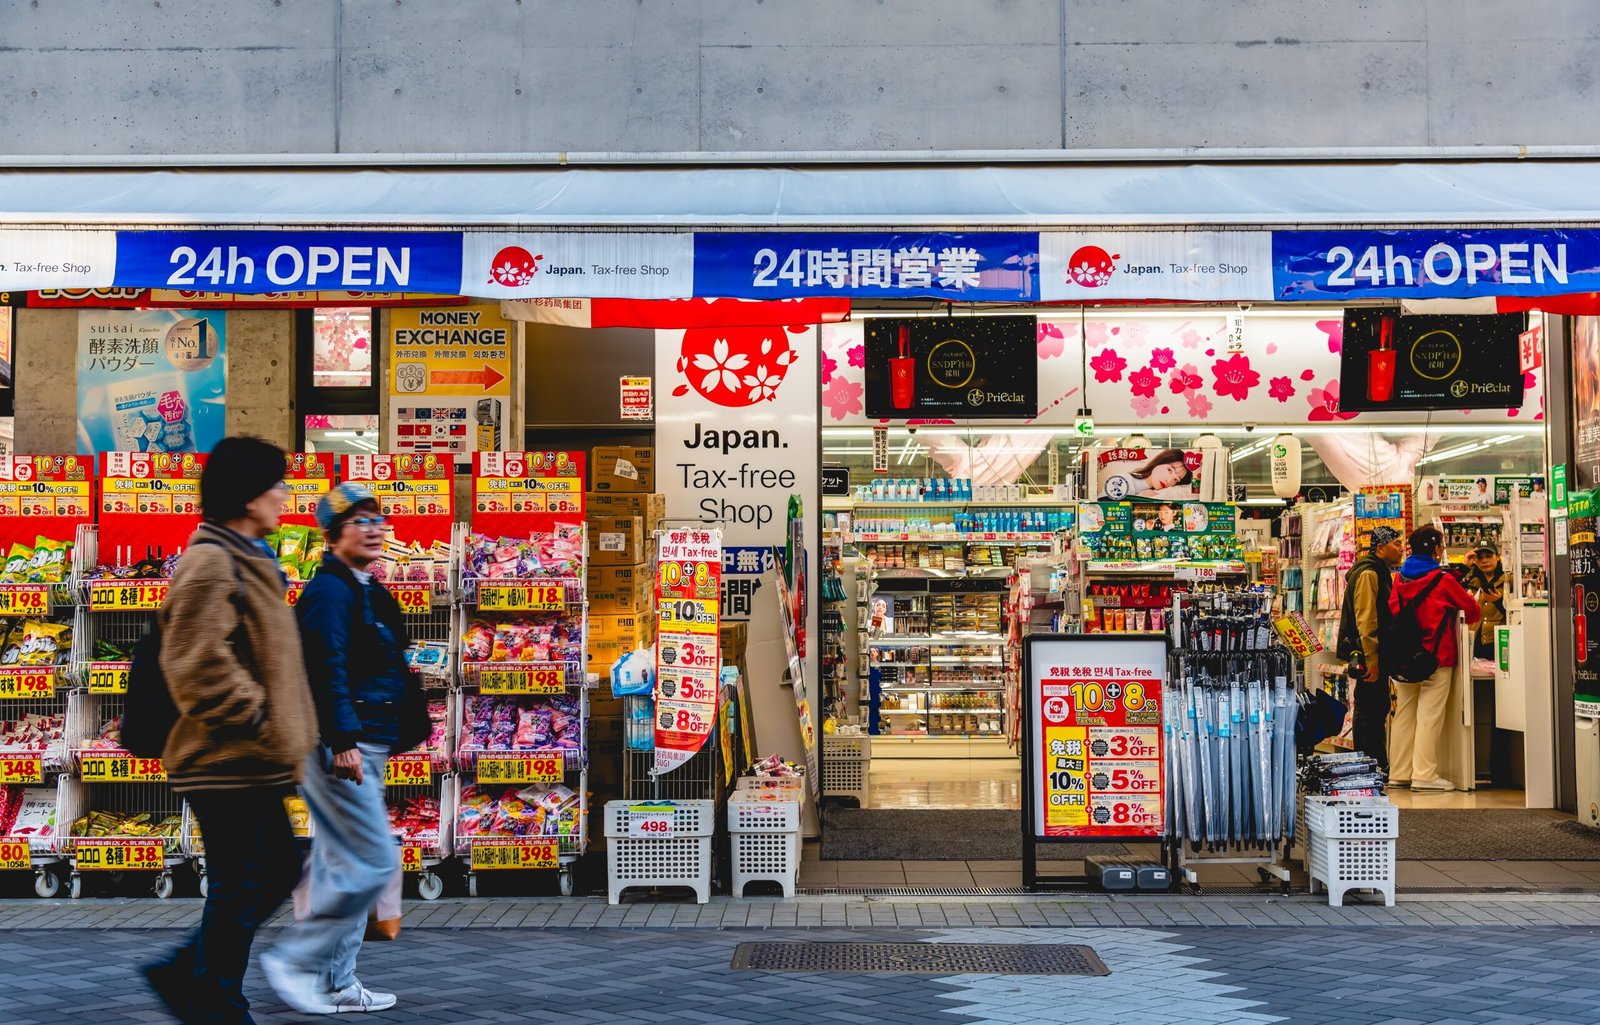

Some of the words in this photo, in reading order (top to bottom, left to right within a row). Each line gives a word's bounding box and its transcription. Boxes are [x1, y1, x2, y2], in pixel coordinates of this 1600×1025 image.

[13, 262, 59, 274] Tax-free
[62, 262, 91, 276] Shop
[167, 245, 255, 286] 24h
[265, 245, 409, 287] OPEN
[545, 264, 586, 277] Japan.
[591, 264, 637, 275] Tax-free
[640, 264, 670, 277] Shop
[753, 247, 981, 289] 24時間営業
[1123, 264, 1164, 278] Japan.
[1169, 263, 1215, 274] Tax-free
[1218, 263, 1248, 277] Shop
[1326, 244, 1413, 287] 24h
[1423, 242, 1569, 286] OPEN
[420, 311, 481, 325] MONEY
[90, 323, 134, 334] suisai
[395, 329, 506, 345] EXCHANGE
[88, 337, 159, 355] 酵素洗顔
[88, 356, 155, 372] パウダー
[160, 393, 184, 411] 毛穴
[683, 422, 789, 455] Japan.
[1107, 449, 1138, 461] 話題の
[676, 462, 796, 489] Tax-free
[1592, 465, 1600, 484] E
[32, 483, 54, 493] 10%
[56, 486, 79, 494] OFF!!
[115, 480, 134, 489] 免税
[149, 480, 172, 491] 10%
[173, 484, 196, 492] OFF!!
[296, 484, 319, 492] OFF!!
[391, 482, 414, 492] 10%
[489, 479, 508, 489] 免税
[523, 479, 546, 490] 10%
[547, 482, 570, 490] OFF!!
[699, 497, 773, 530] Shop
[662, 546, 678, 558] 면세
[682, 547, 718, 558] Tax-free
[660, 561, 690, 587] 10%
[695, 562, 717, 587] 8%
[11, 593, 46, 607] 198円
[92, 589, 115, 605] コロロ
[120, 588, 138, 606] 各種
[527, 588, 562, 603] 118円
[673, 600, 704, 622] 10%
[696, 613, 716, 624] OFF!!
[681, 642, 705, 665] 3%
[695, 655, 715, 666] OFF
[91, 672, 114, 688] コロロ
[527, 671, 562, 686] 198円
[1094, 667, 1114, 677] 면세
[1115, 667, 1152, 677] Tax-free
[16, 675, 52, 691] 198円
[680, 676, 704, 699] 5%
[694, 689, 714, 699] OFF
[1070, 682, 1116, 712] 10%
[1124, 682, 1158, 712] 8%
[676, 709, 701, 731] 8%
[690, 722, 709, 733] OFF
[1050, 739, 1083, 756] 免税
[1110, 735, 1143, 756] 3%
[1130, 746, 1156, 756] OFF
[4, 761, 39, 776] 348円
[83, 760, 106, 776] コロロ
[111, 759, 129, 778] 各種
[129, 759, 166, 774] 138円
[392, 762, 428, 778] 198円
[525, 760, 560, 775] 198円
[656, 759, 670, 768] SUGI
[1057, 758, 1076, 770] 最大
[1050, 771, 1085, 791] 10%
[1111, 769, 1144, 790] 5%
[1131, 780, 1158, 790] OFF
[1050, 794, 1085, 806] OFF!!
[1113, 803, 1145, 824] 8%
[1132, 814, 1158, 823] OFF
[641, 821, 673, 832] 498円
[77, 848, 100, 864] コロロ
[105, 847, 124, 865] 各種
[124, 847, 162, 862] 138円
[521, 846, 556, 861] 398円
